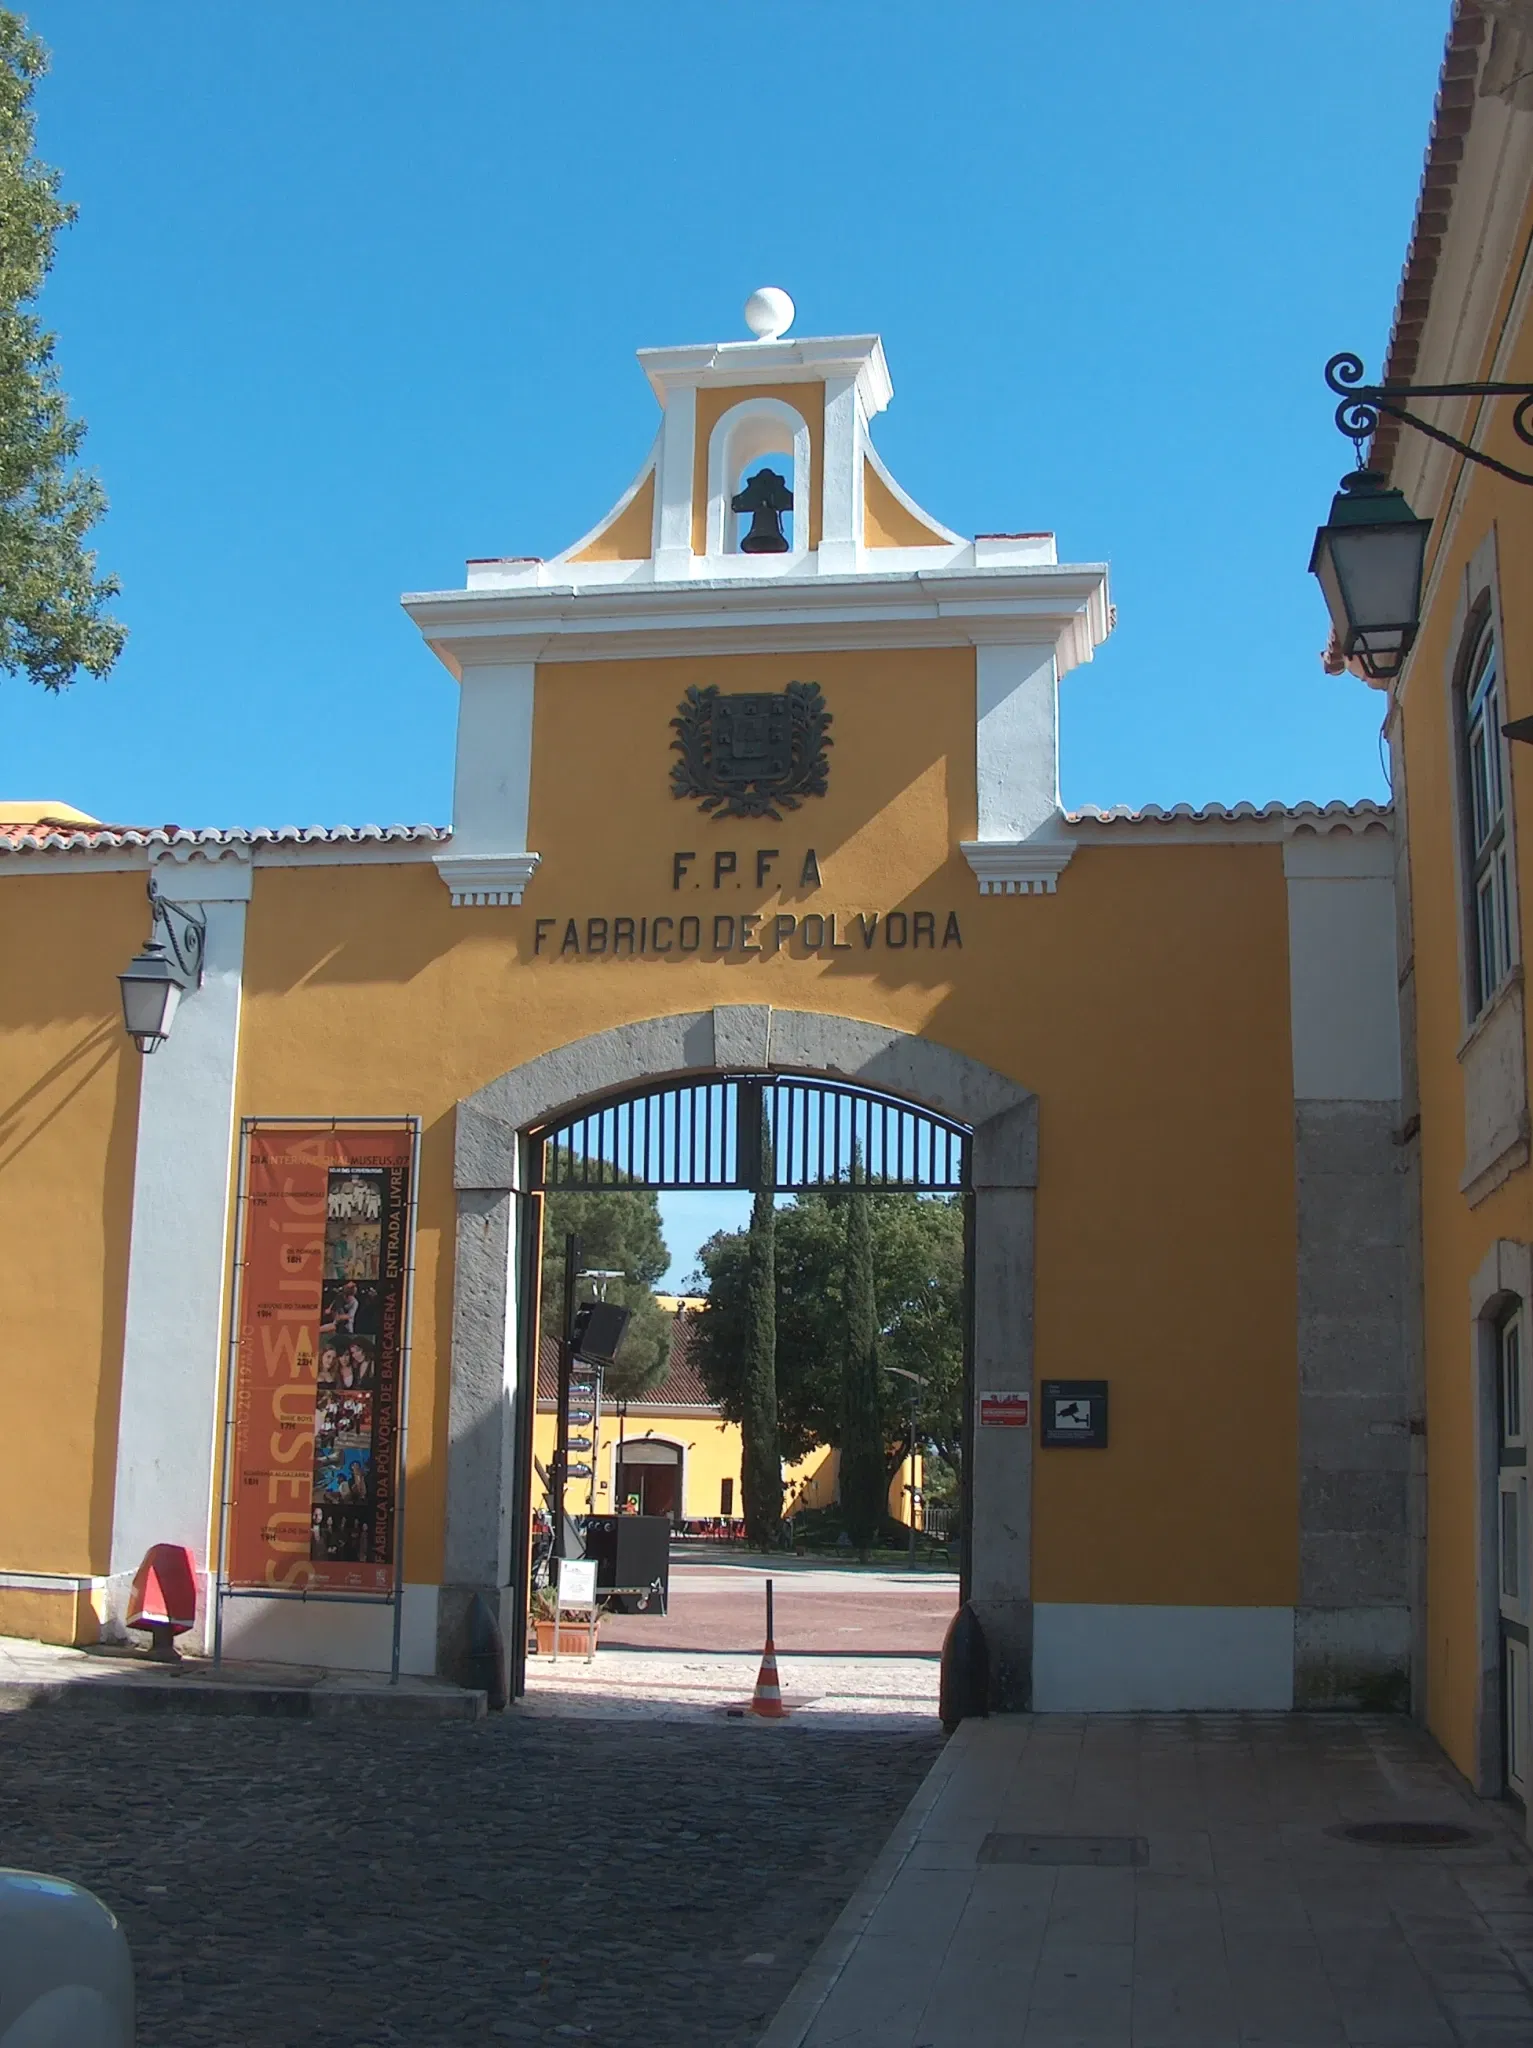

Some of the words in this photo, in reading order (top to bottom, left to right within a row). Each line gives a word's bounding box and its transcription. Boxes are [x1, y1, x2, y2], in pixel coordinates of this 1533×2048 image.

[534, 915, 701, 956] FABRICO
[713, 914, 763, 954] DE
[776, 910, 964, 952] POLVORA
[391, 1167, 403, 1208] LIVRE
[387, 1212, 400, 1278] ENTRADA
[382, 1293, 396, 1377] BARCARENA
[380, 1383, 392, 1401] DE
[376, 1409, 392, 1474] PÓLVORA
[377, 1480, 388, 1498] DA
